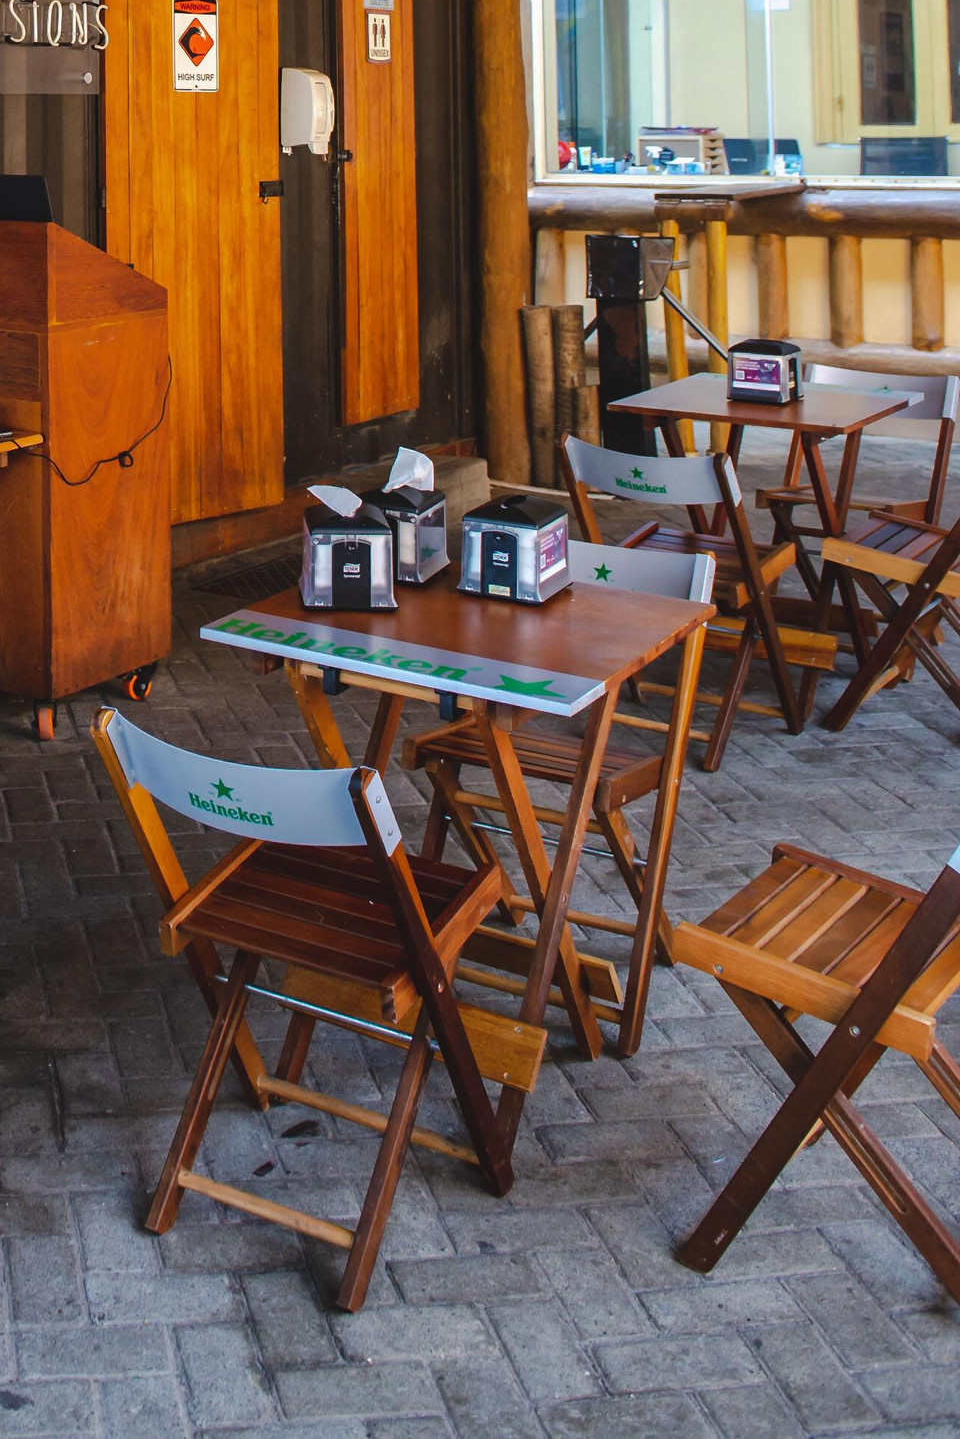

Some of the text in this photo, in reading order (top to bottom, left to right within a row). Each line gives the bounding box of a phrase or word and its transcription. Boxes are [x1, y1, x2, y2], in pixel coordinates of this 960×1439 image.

[180, 3, 211, 12] WARNING
[177, 73, 214, 81] HIGH SURF
[615, 476, 668, 494] Heineken
[213, 618, 470, 681] Heineken
[188, 791, 275, 826] Heineken
